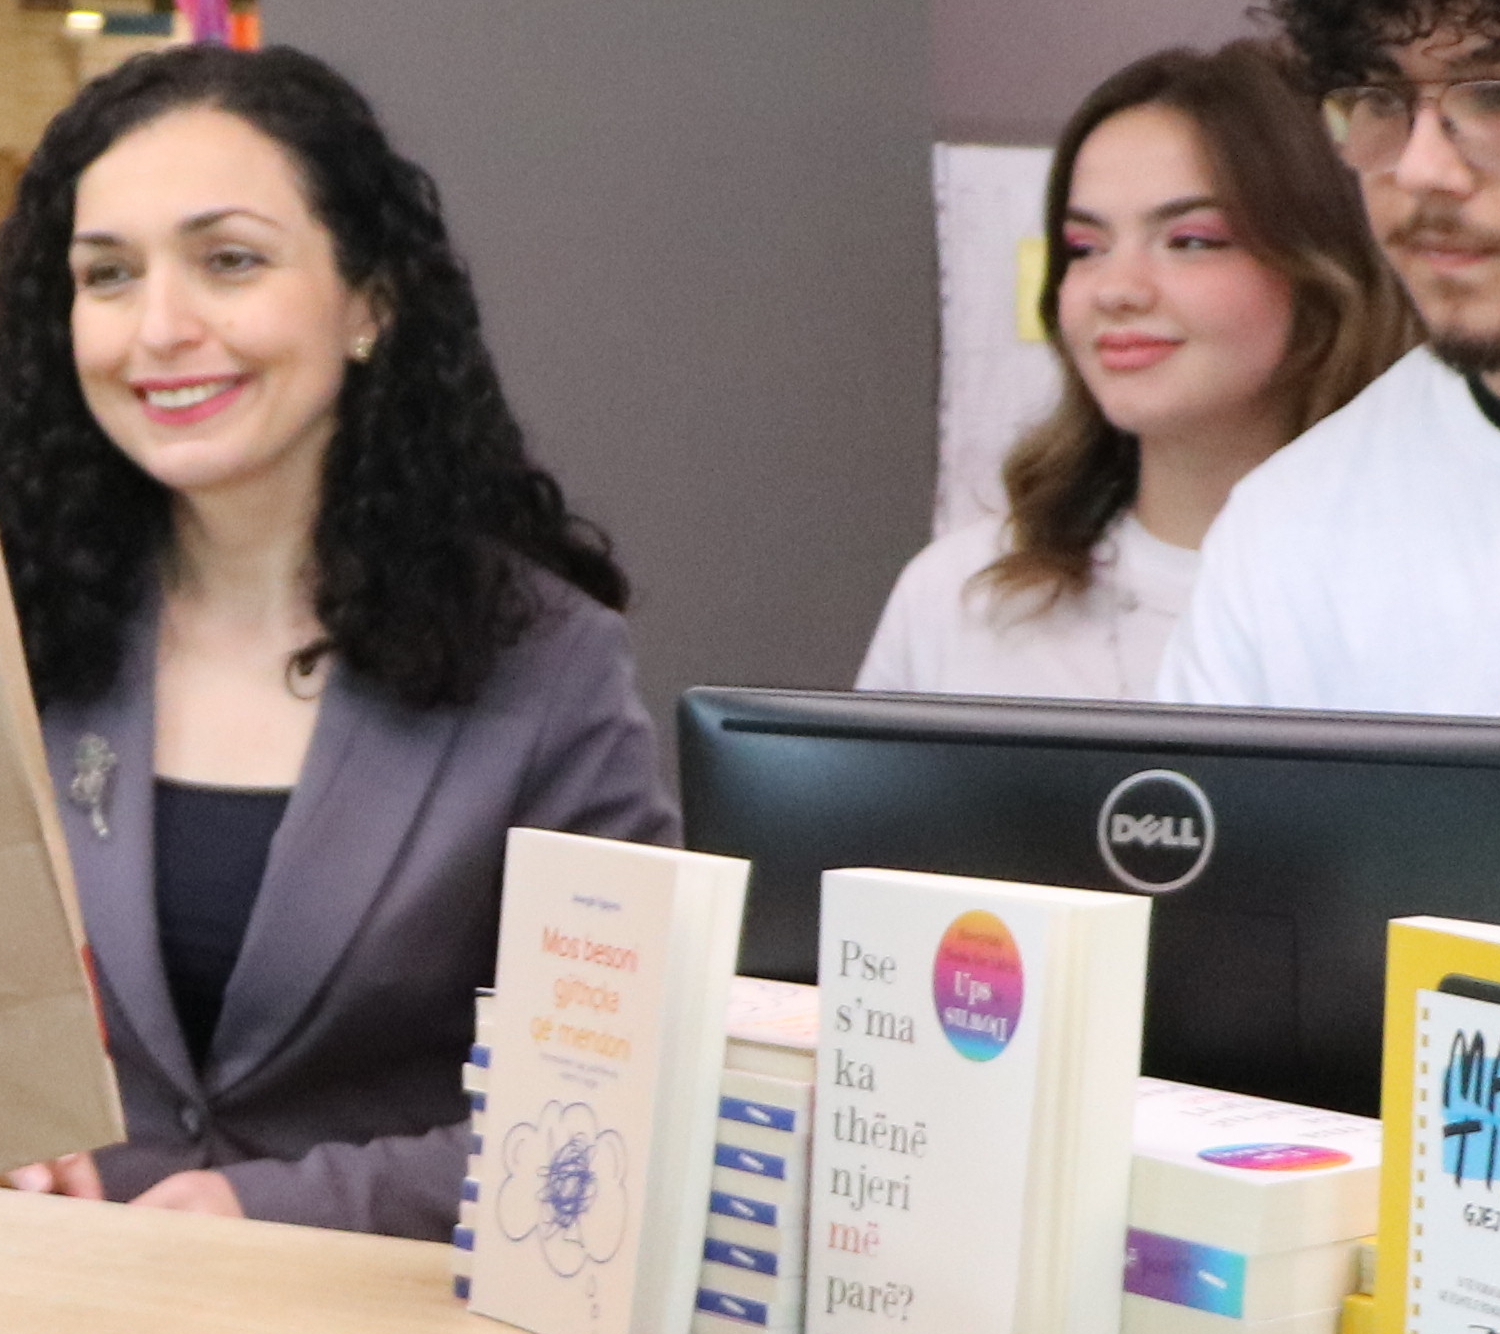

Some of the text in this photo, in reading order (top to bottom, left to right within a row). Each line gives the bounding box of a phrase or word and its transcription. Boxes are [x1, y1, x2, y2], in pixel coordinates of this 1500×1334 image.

[1111, 813, 1202, 847] DELL
[839, 938, 898, 985] Pse
[834, 1048, 876, 1092] ka
[832, 1104, 928, 1160] thënë
[829, 1163, 913, 1213] njeri
[827, 1221, 882, 1258] më
[825, 1275, 915, 1323] parë?
